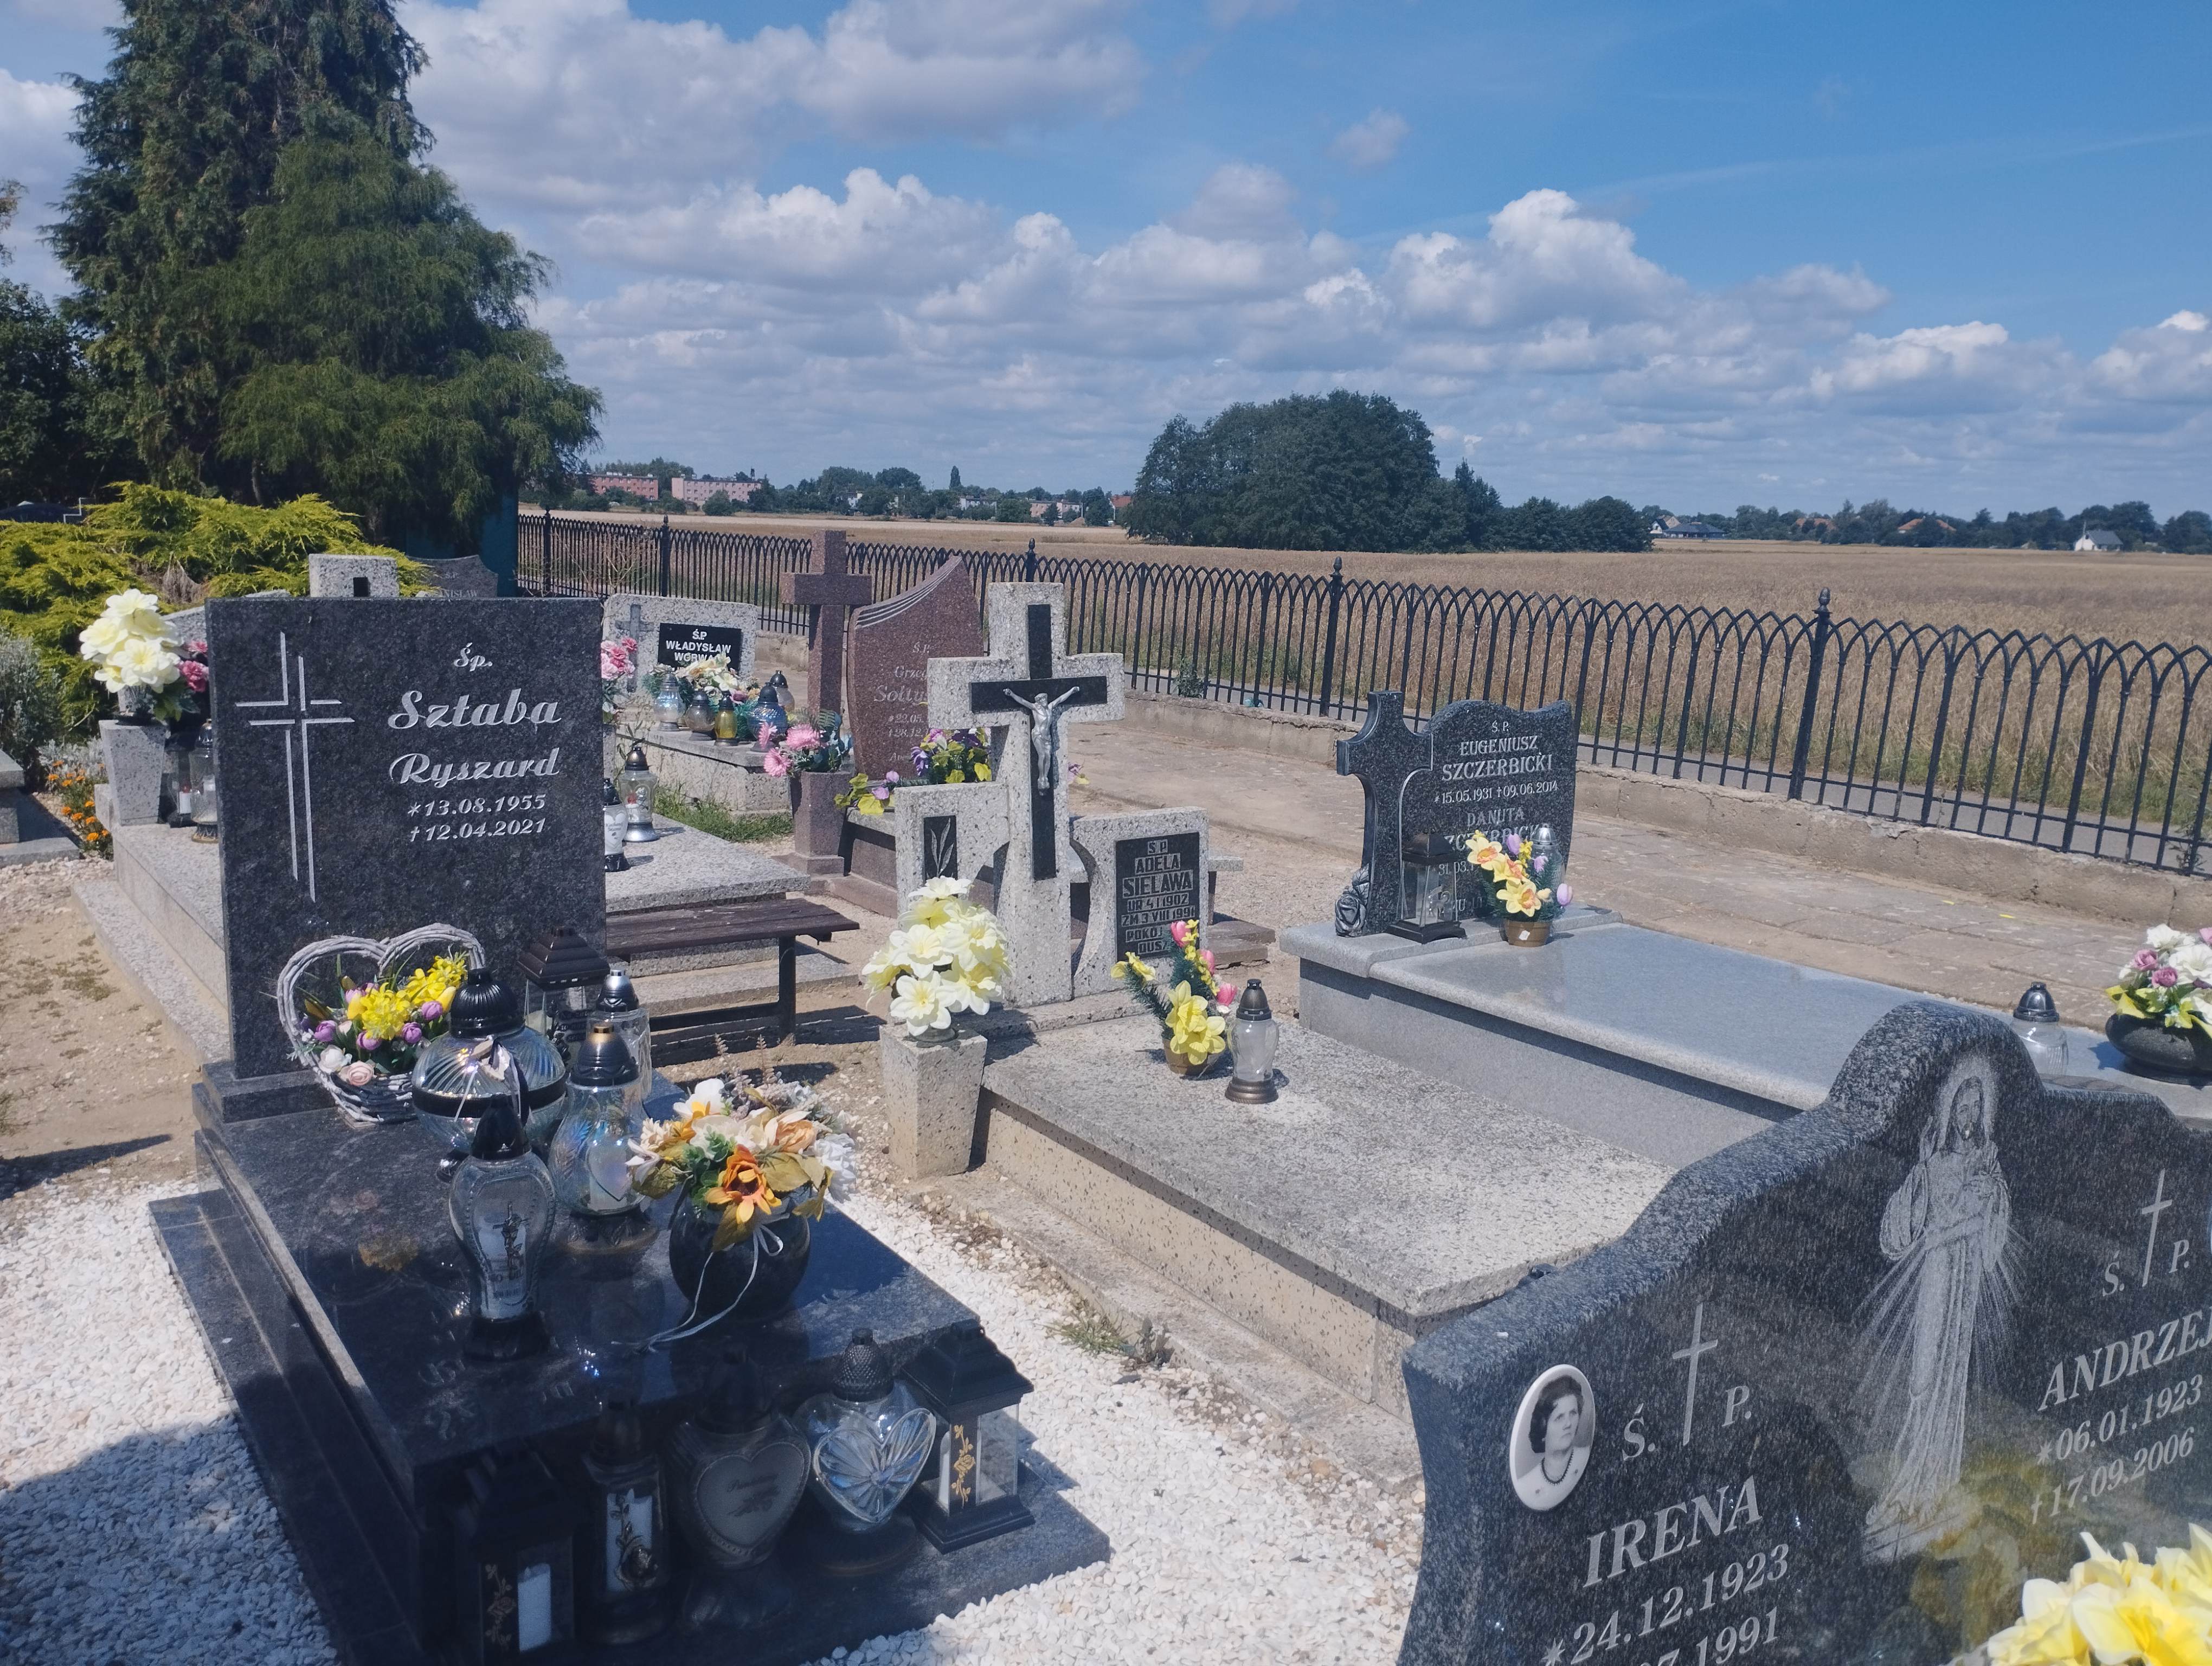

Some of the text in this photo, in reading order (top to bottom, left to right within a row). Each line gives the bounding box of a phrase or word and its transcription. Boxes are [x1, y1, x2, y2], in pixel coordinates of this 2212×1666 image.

[454, 643, 493, 671] Śp.
[665, 640, 731, 653] WŁADYSŁAW
[388, 688, 562, 729] Sztaba
[1459, 735, 1539, 756] EUGENIUSZ
[389, 747, 561, 789] Ryszard
[1441, 753, 1553, 781] SZCZERBICKI
[1467, 806, 1526, 828] DANUTA
[1136, 854, 1180, 874] ADELA
[1123, 871, 1192, 897] SIELAWA
[1128, 899, 1142, 912] UR
[1146, 899, 1153, 909] 4
[1162, 894, 1188, 907] 1902
[1122, 914, 1139, 926] ZM
[1142, 913, 1149, 924] 3
[1152, 910, 1170, 922] VIII
[2037, 1306, 2212, 1411] ANDRZEJ
[1583, 1474, 1763, 1588] IRENA
